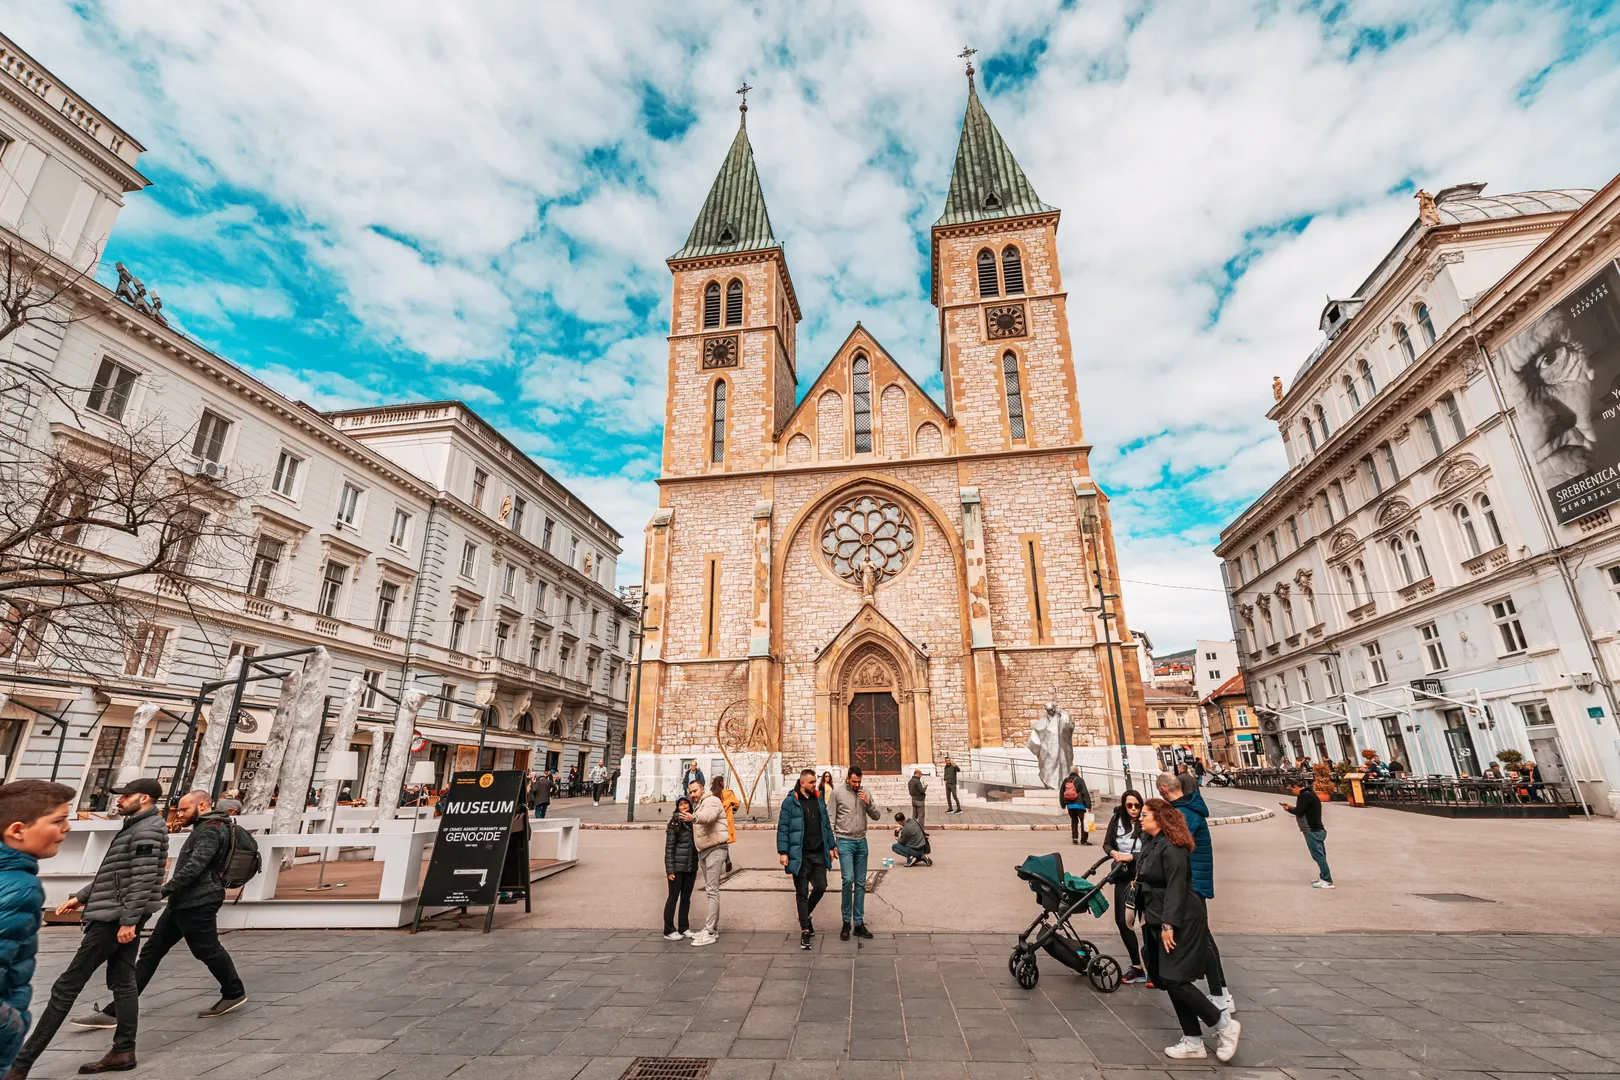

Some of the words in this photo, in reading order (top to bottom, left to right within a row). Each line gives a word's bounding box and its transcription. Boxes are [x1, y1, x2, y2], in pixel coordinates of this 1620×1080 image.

[1570, 283, 1605, 312] GALLERY
[1572, 289, 1608, 318] 11/07/95
[1602, 407, 1616, 420] my
[1556, 466, 1618, 503] SREBRENICA
[1561, 487, 1612, 514] MEMORIAL
[725, 717, 773, 748] SA
[446, 800, 514, 815] MUSEUM
[445, 831, 501, 842] GENOCIDE
